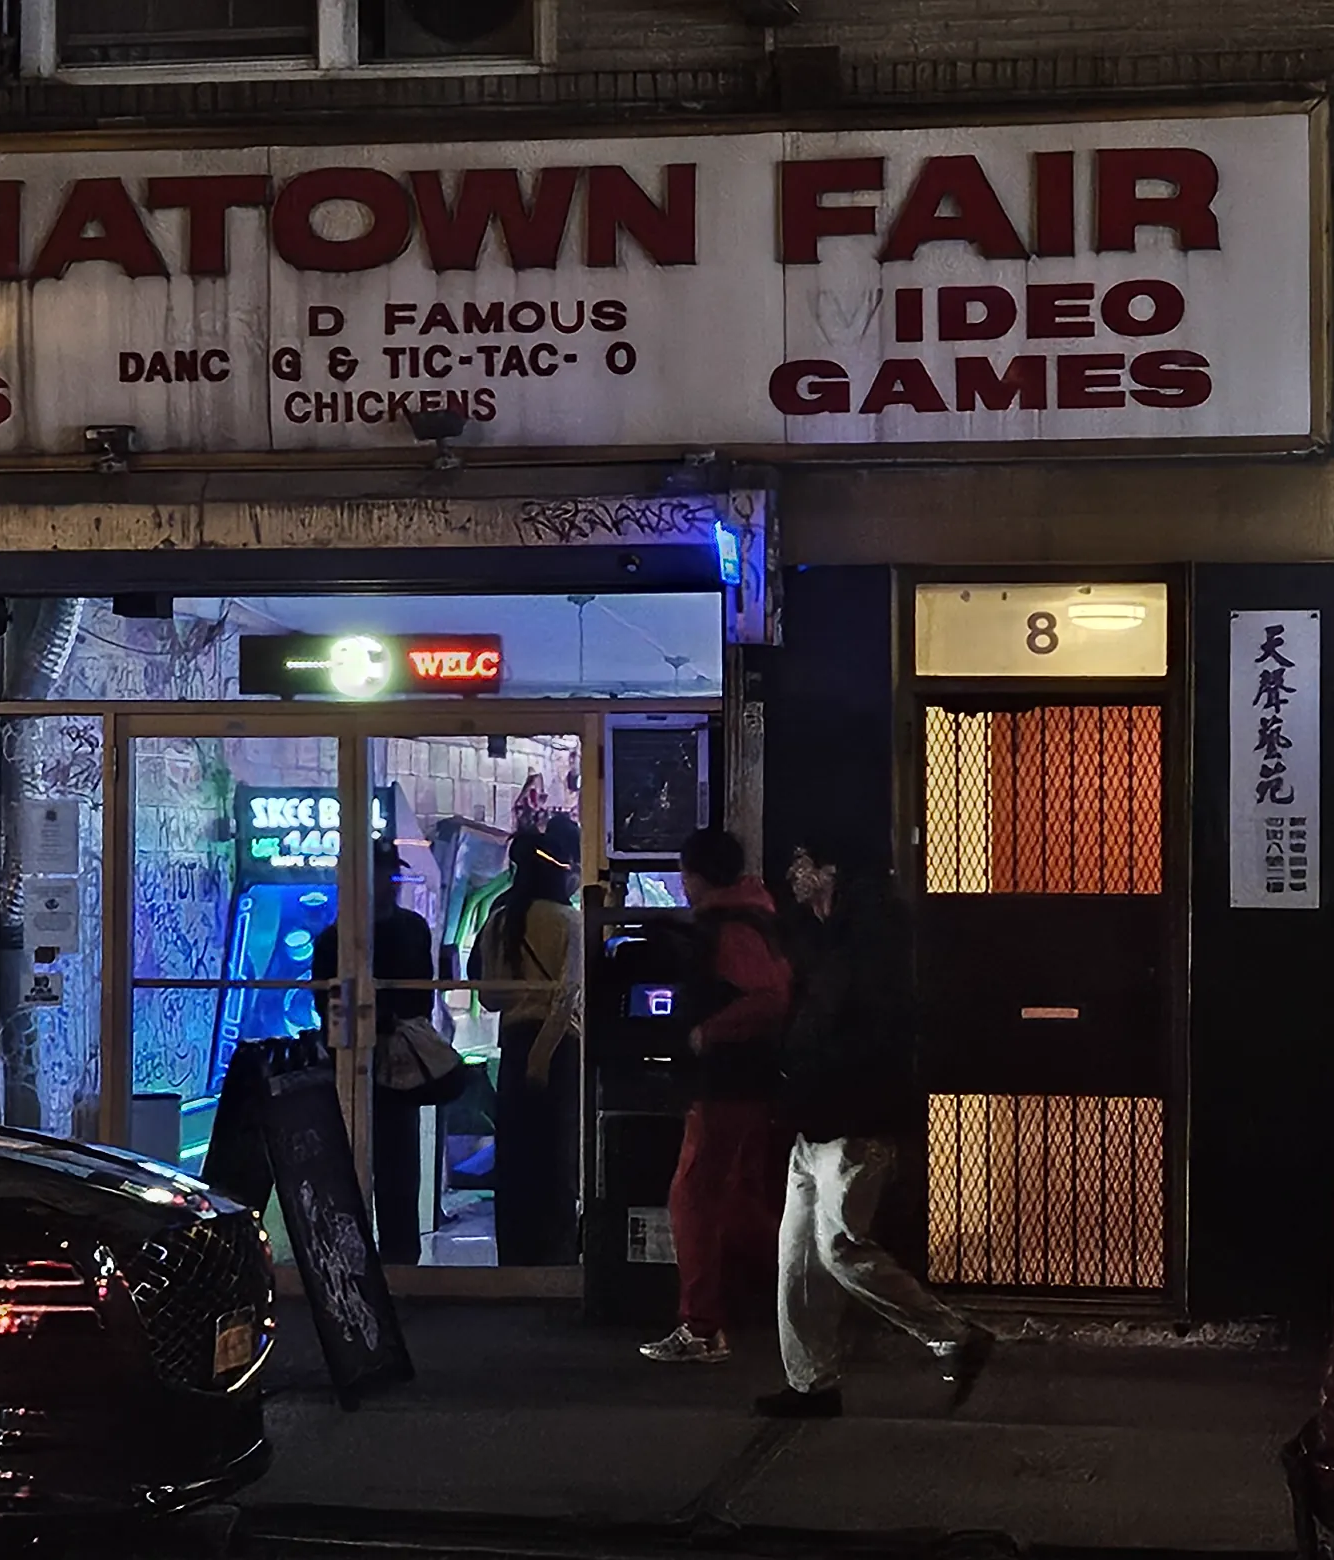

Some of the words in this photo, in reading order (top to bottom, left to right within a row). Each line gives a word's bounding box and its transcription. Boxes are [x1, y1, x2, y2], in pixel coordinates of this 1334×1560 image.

[778, 148, 1221, 264] FAIR
[384, 299, 628, 336] FAMOUS
[327, 346, 359, 384] &
[769, 349, 1213, 416] GAMES
[284, 388, 497, 424] CHICKENS
[1025, 611, 1059, 655] 8
[409, 652, 499, 678] WELC
